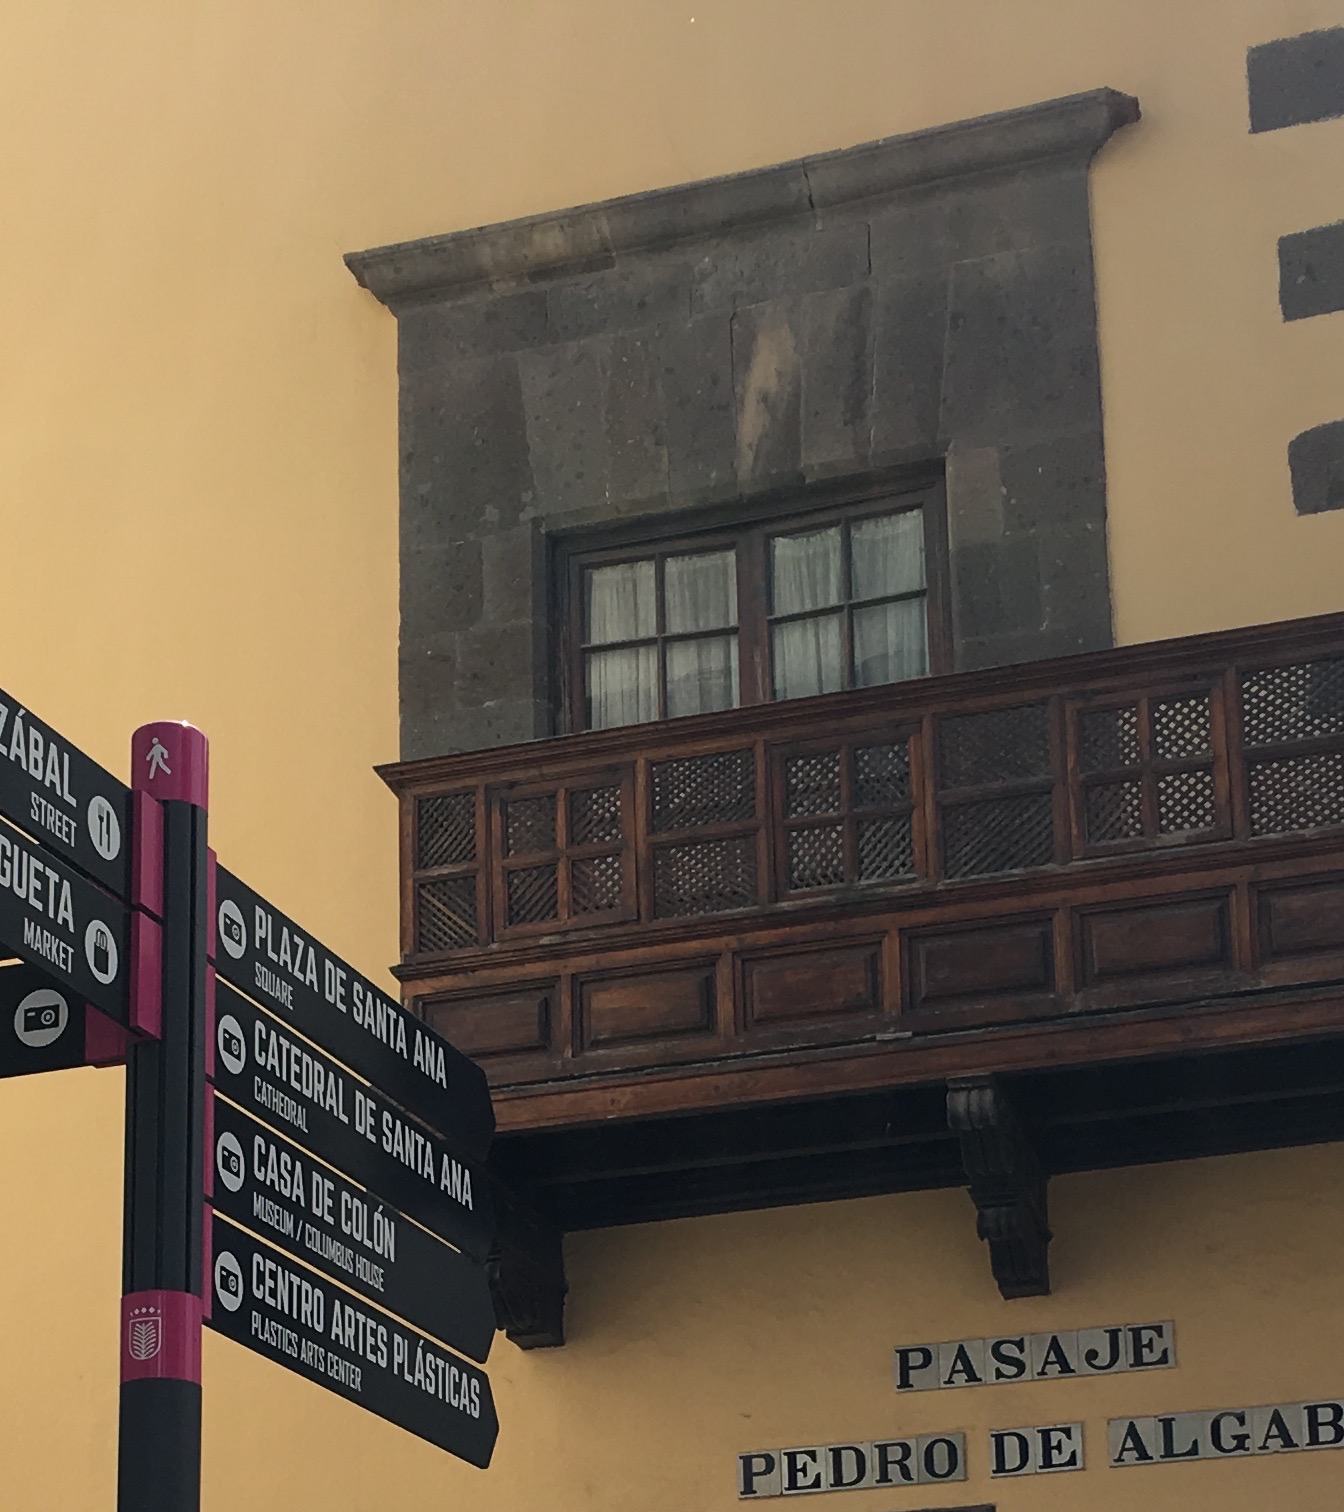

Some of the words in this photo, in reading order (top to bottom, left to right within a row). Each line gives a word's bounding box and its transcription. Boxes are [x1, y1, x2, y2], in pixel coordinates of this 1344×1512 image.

[31, 791, 77, 848] STREET
[24, 917, 75, 974] MARKET
[255, 961, 294, 1011] SQUARE
[255, 904, 319, 993] PLAZA
[325, 958, 347, 1014] DE
[353, 981, 408, 1060] SANTA
[413, 1029, 447, 1089] ANA
[255, 1075, 309, 1134] CATHEDRAL
[255, 1019, 349, 1125] CATEDRAL
[355, 1089, 377, 1144] DE
[382, 1110, 435, 1185] SANTA
[440, 1153, 473, 1211] ANA
[253, 1134, 305, 1208] CASA
[312, 1170, 335, 1226] DE
[341, 1190, 395, 1263] COLÓN
[253, 1191, 294, 1239] MUSEUM
[305, 1223, 354, 1274] COLUMBUS
[356, 1253, 385, 1293] HOUSE
[251, 1310, 298, 1359] PLASTICS
[300, 1338, 325, 1372] ARTS
[327, 1351, 362, 1393] CENTER
[252, 1252, 325, 1333] CENTRO
[331, 1299, 388, 1369] ARTES
[393, 1333, 480, 1419] PLÁSTICAS
[895, 1323, 1169, 1390] PASAJE
[739, 1438, 959, 1496] PEDRO
[991, 1428, 1080, 1474] DE
